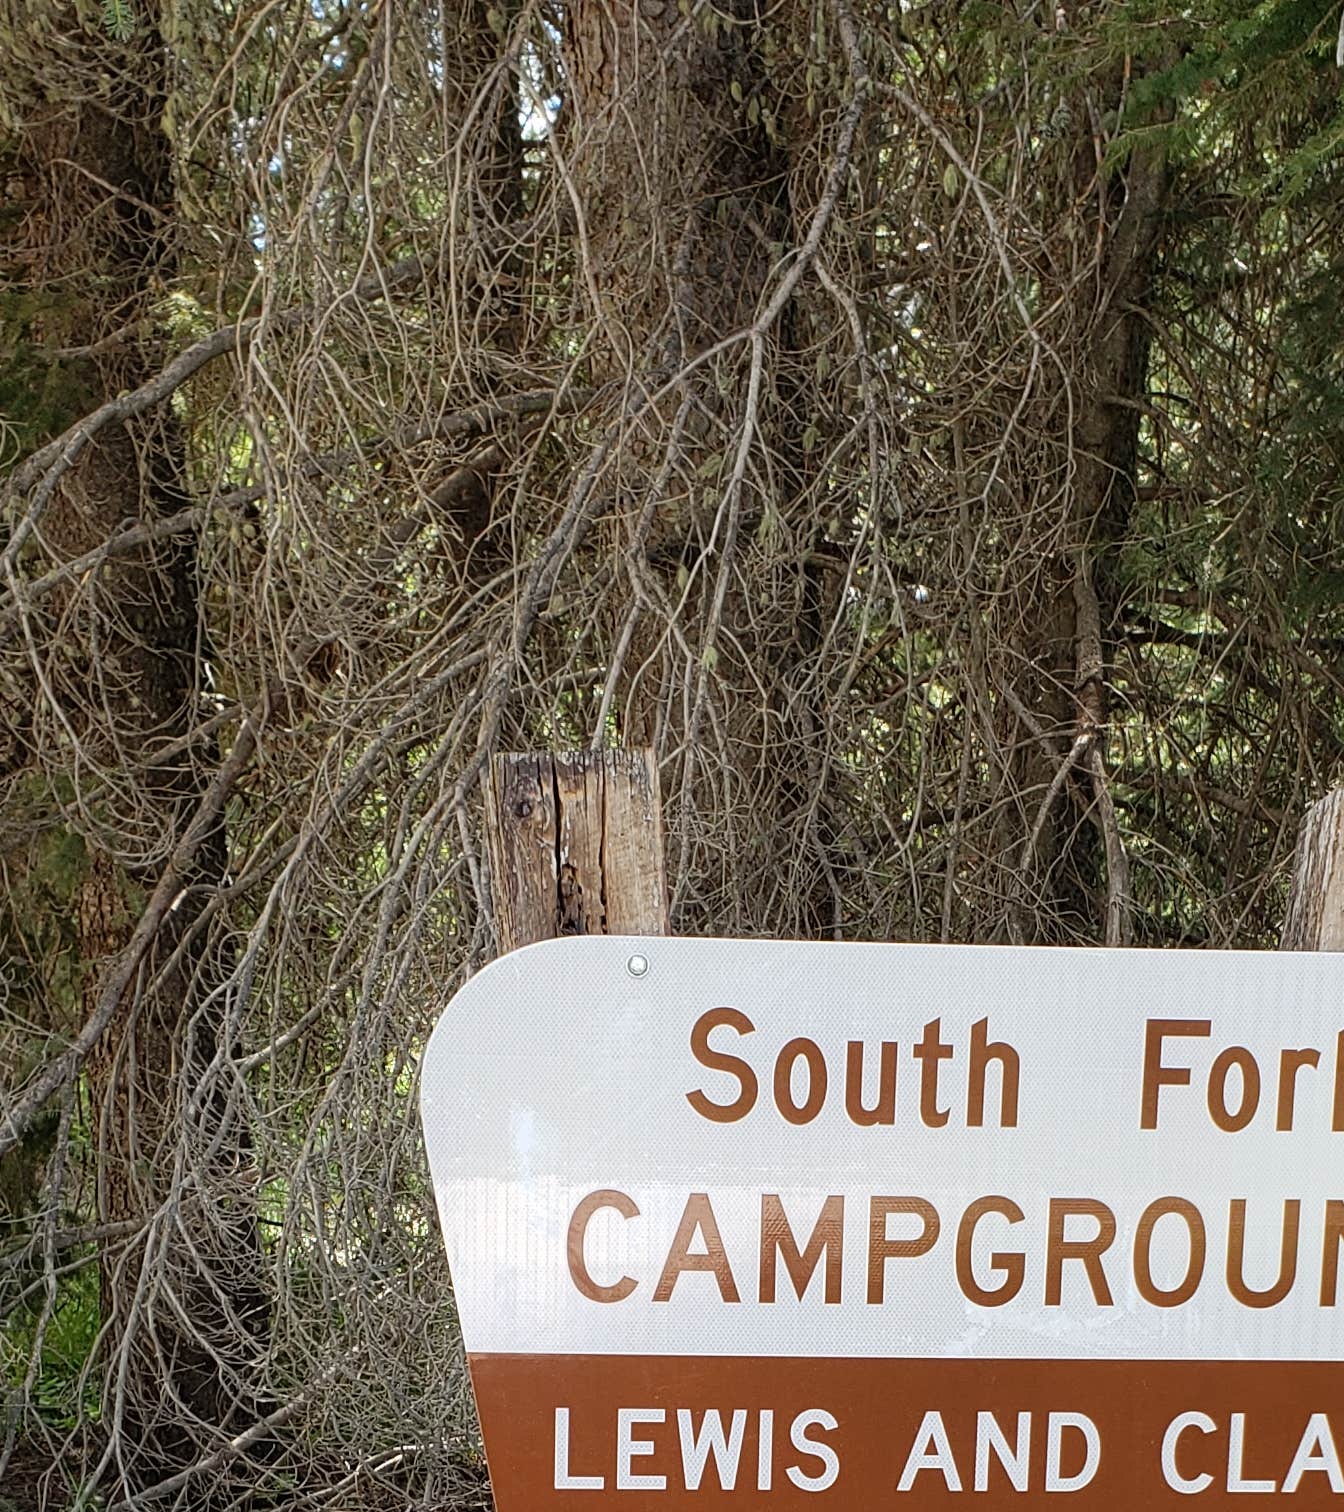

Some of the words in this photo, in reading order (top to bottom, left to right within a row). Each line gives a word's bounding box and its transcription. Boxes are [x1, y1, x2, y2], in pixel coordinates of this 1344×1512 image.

[687, 1007, 1020, 1128] South
[553, 1407, 840, 1492] LEWIS
[897, 1411, 1102, 1493] AND
